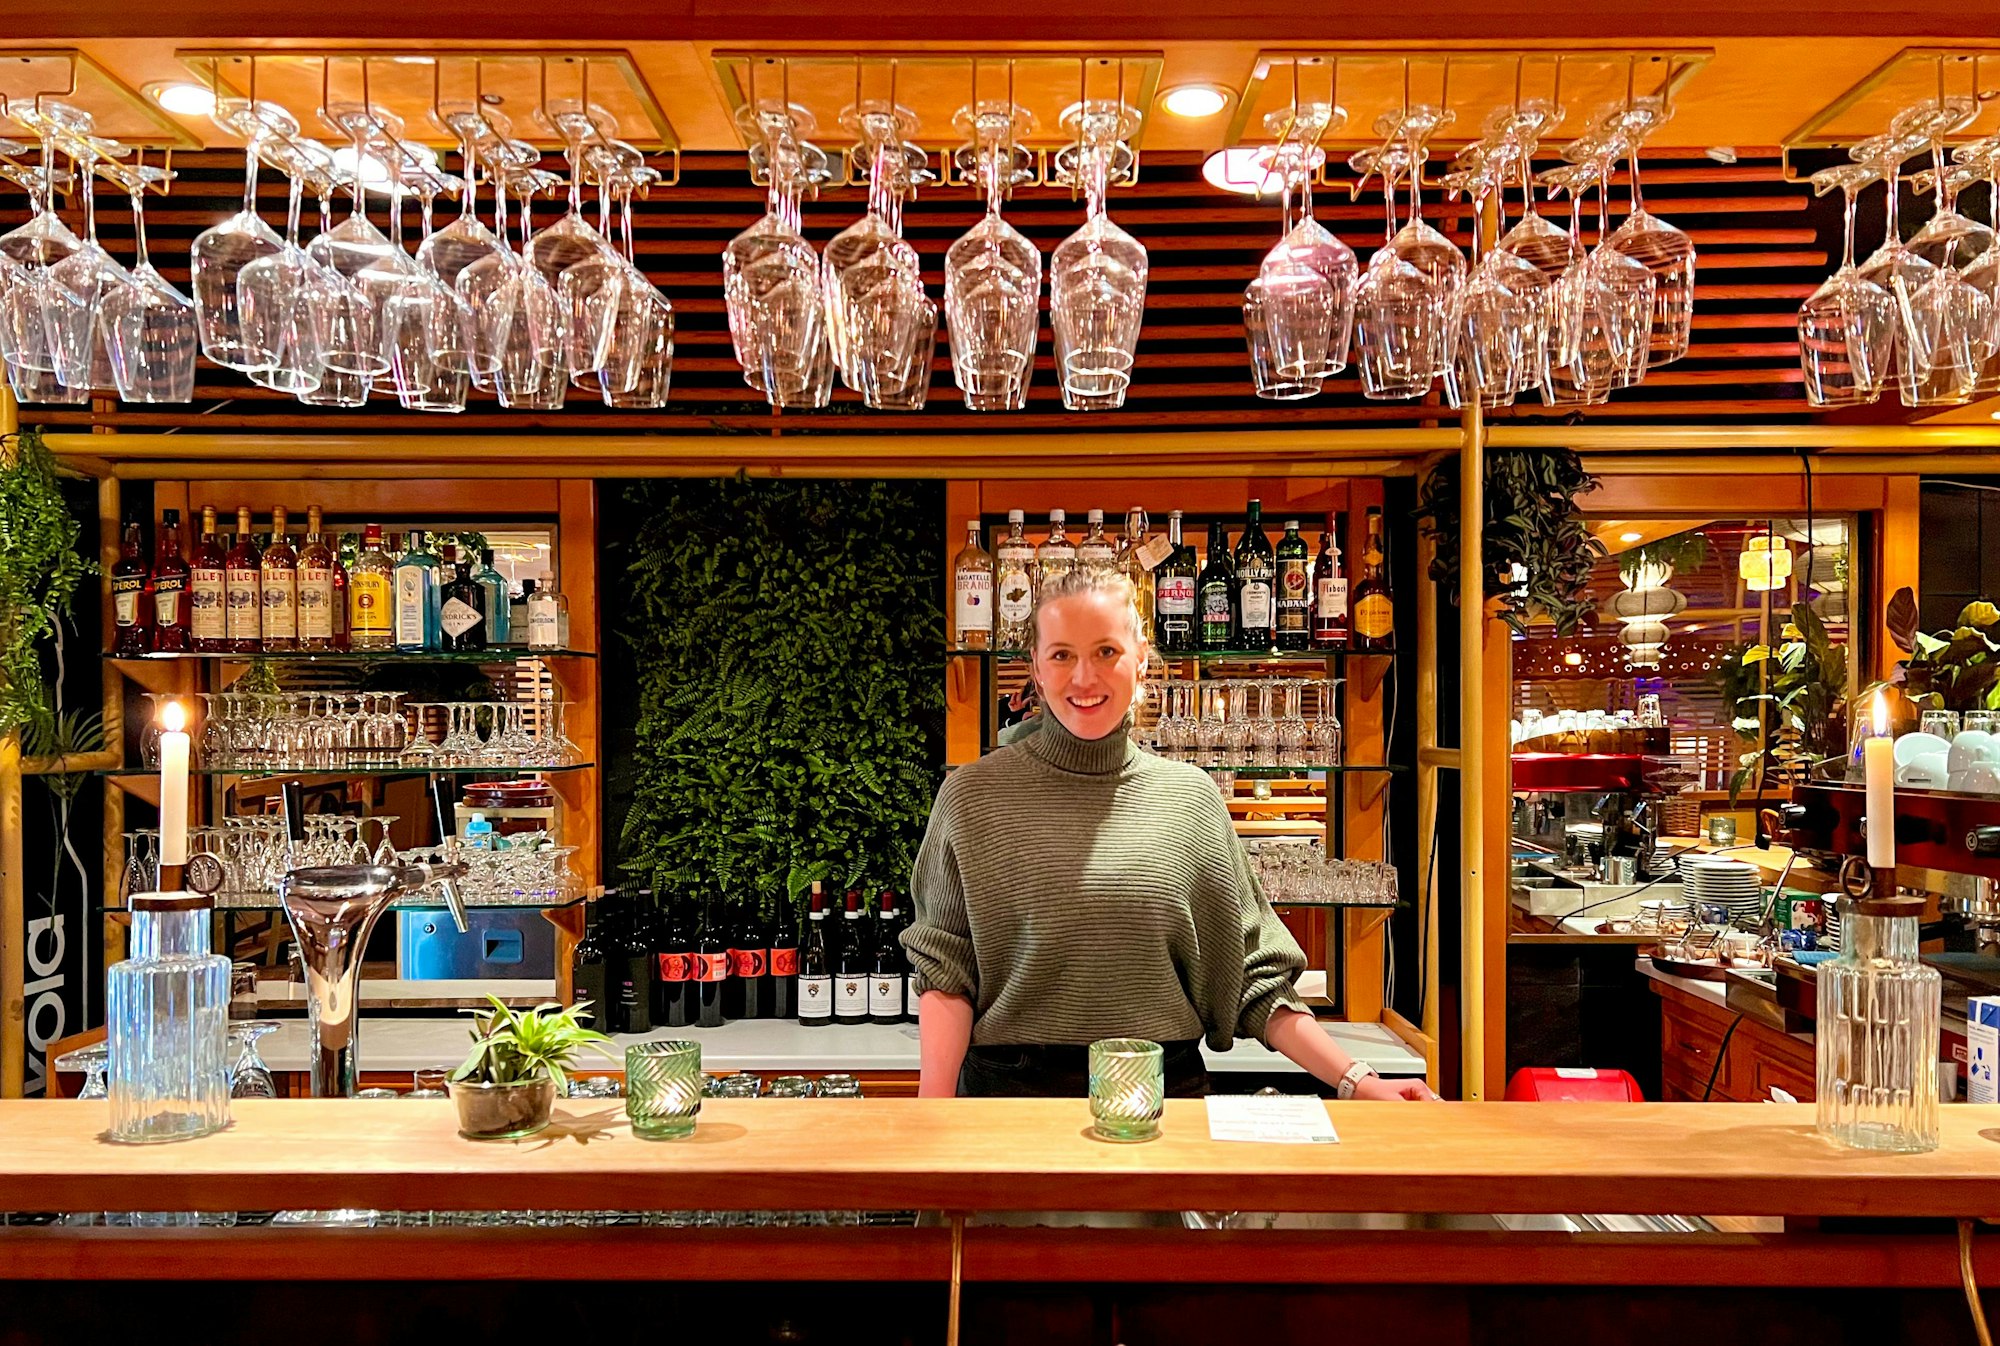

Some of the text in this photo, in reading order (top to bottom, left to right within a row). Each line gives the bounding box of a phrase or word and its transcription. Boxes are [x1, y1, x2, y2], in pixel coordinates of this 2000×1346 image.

[192, 572, 223, 582] ILLET
[228, 572, 258, 582] ILLET
[264, 572, 293, 581] ILLET
[299, 572, 328, 581] ILLET
[113, 580, 142, 591] PEROL
[153, 580, 183, 591] PEROL
[957, 581, 990, 591] BRAND
